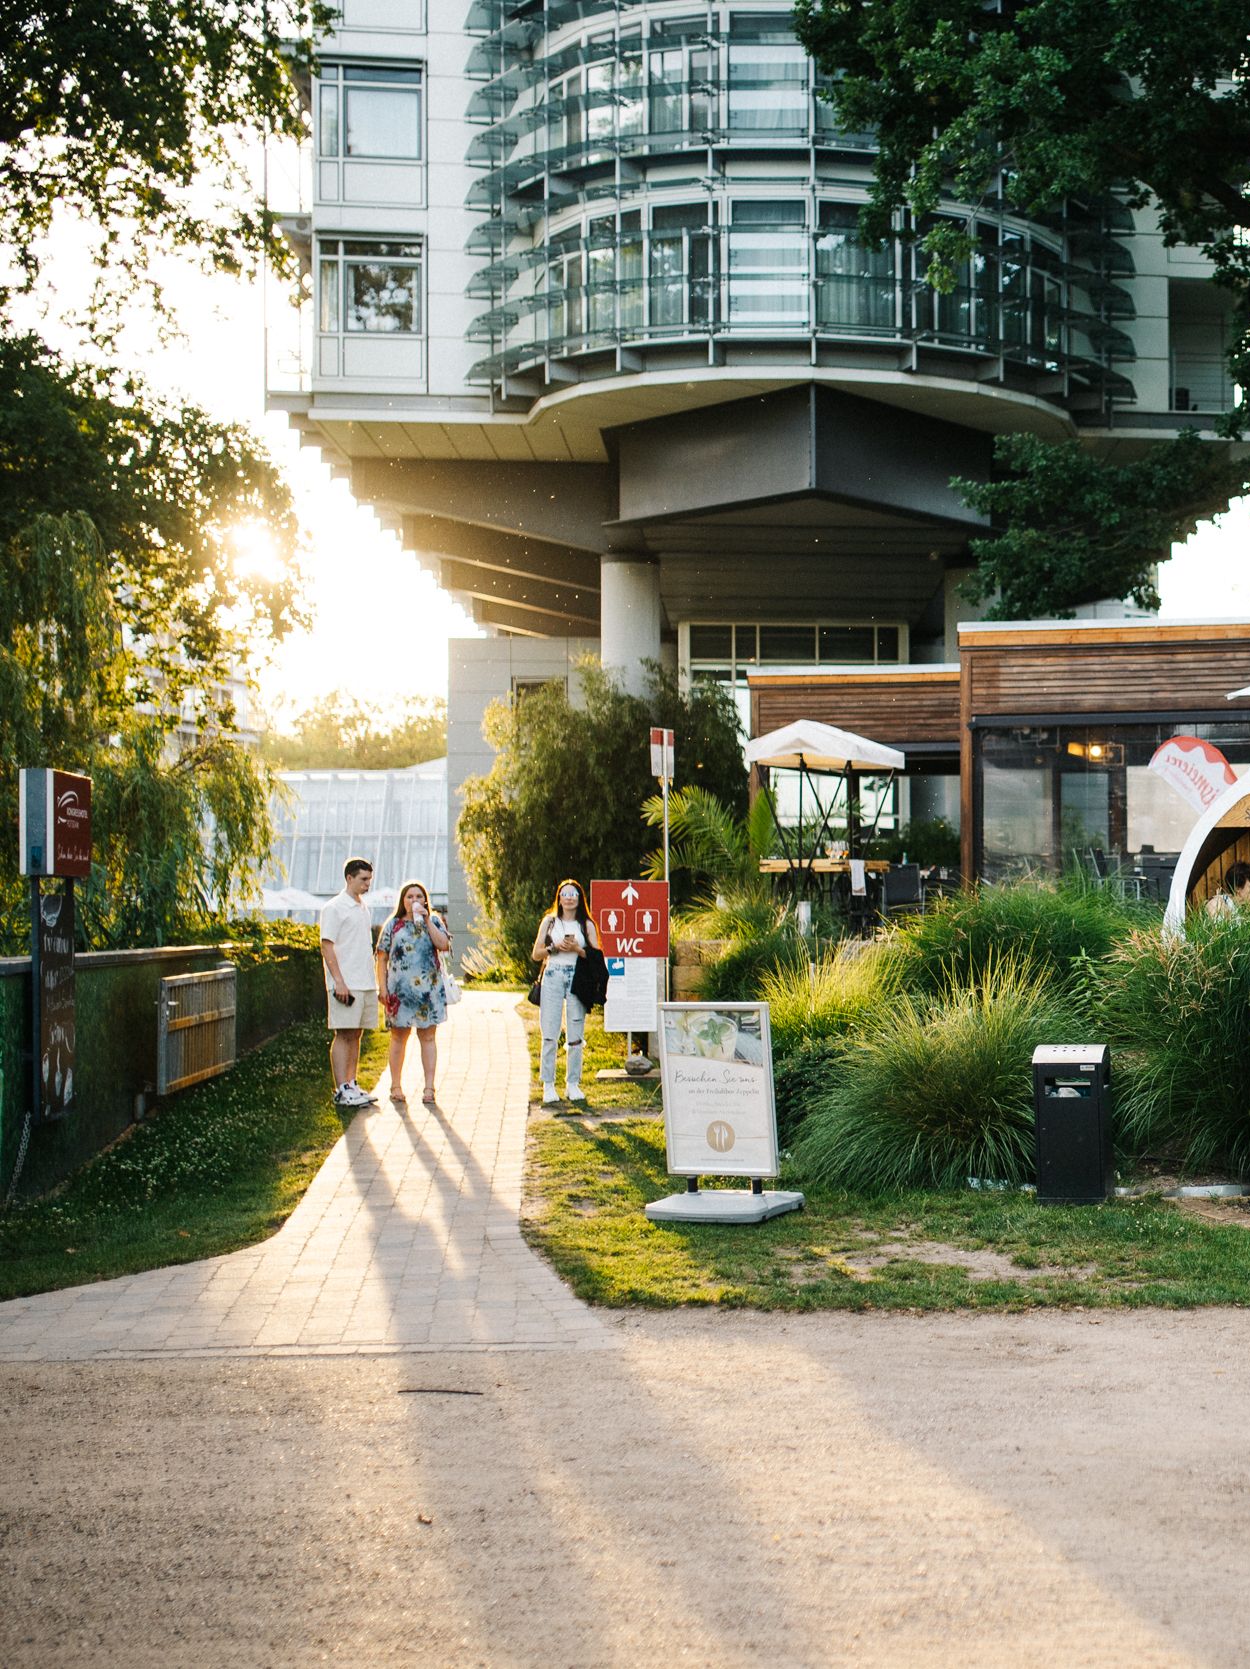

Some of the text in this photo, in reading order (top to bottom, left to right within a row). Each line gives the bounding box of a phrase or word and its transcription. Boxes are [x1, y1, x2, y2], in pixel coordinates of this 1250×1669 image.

[616, 937, 645, 954] WC
[674, 1068, 717, 1084] Besuchen
[719, 1068, 737, 1084] Sie
